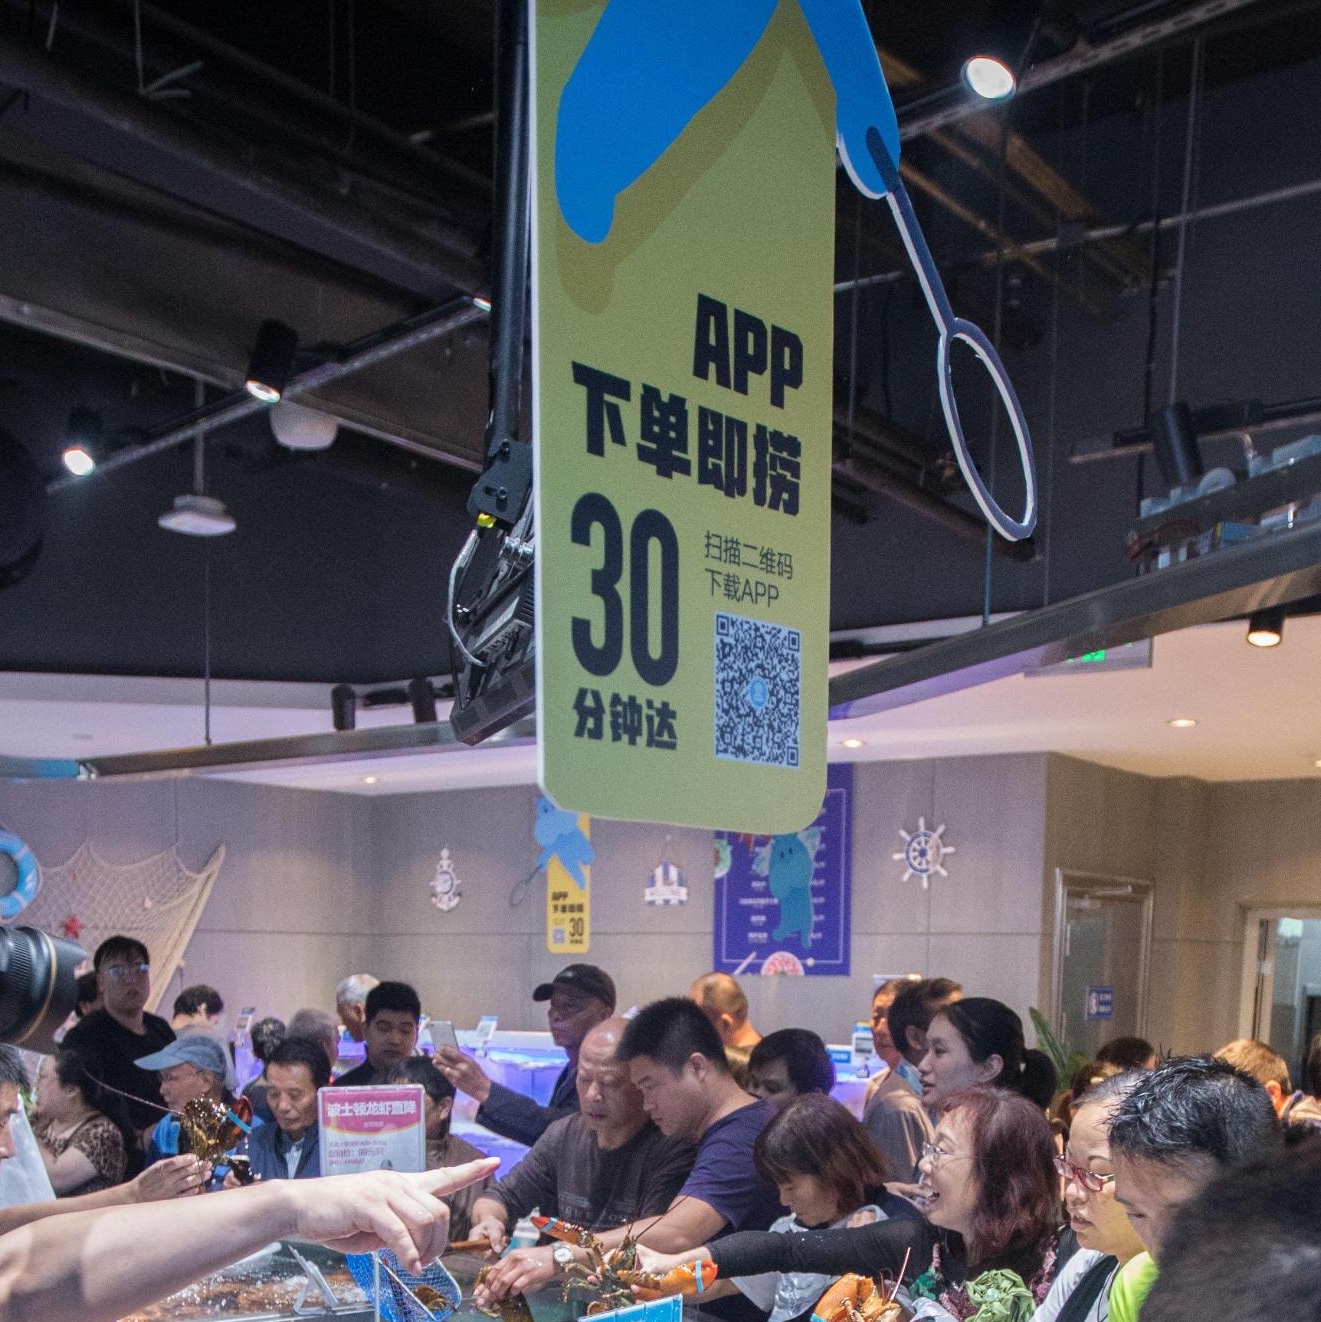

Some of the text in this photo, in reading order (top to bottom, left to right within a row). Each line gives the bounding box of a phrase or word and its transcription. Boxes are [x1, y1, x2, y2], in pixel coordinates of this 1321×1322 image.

[692, 293, 804, 410] APP
[571, 361, 802, 516] 下单即捞
[570, 492, 679, 687] 30
[703, 530, 794, 581] 扫描二维码
[704, 566, 780, 608] 下载APP
[573, 687, 679, 751] 分钟达
